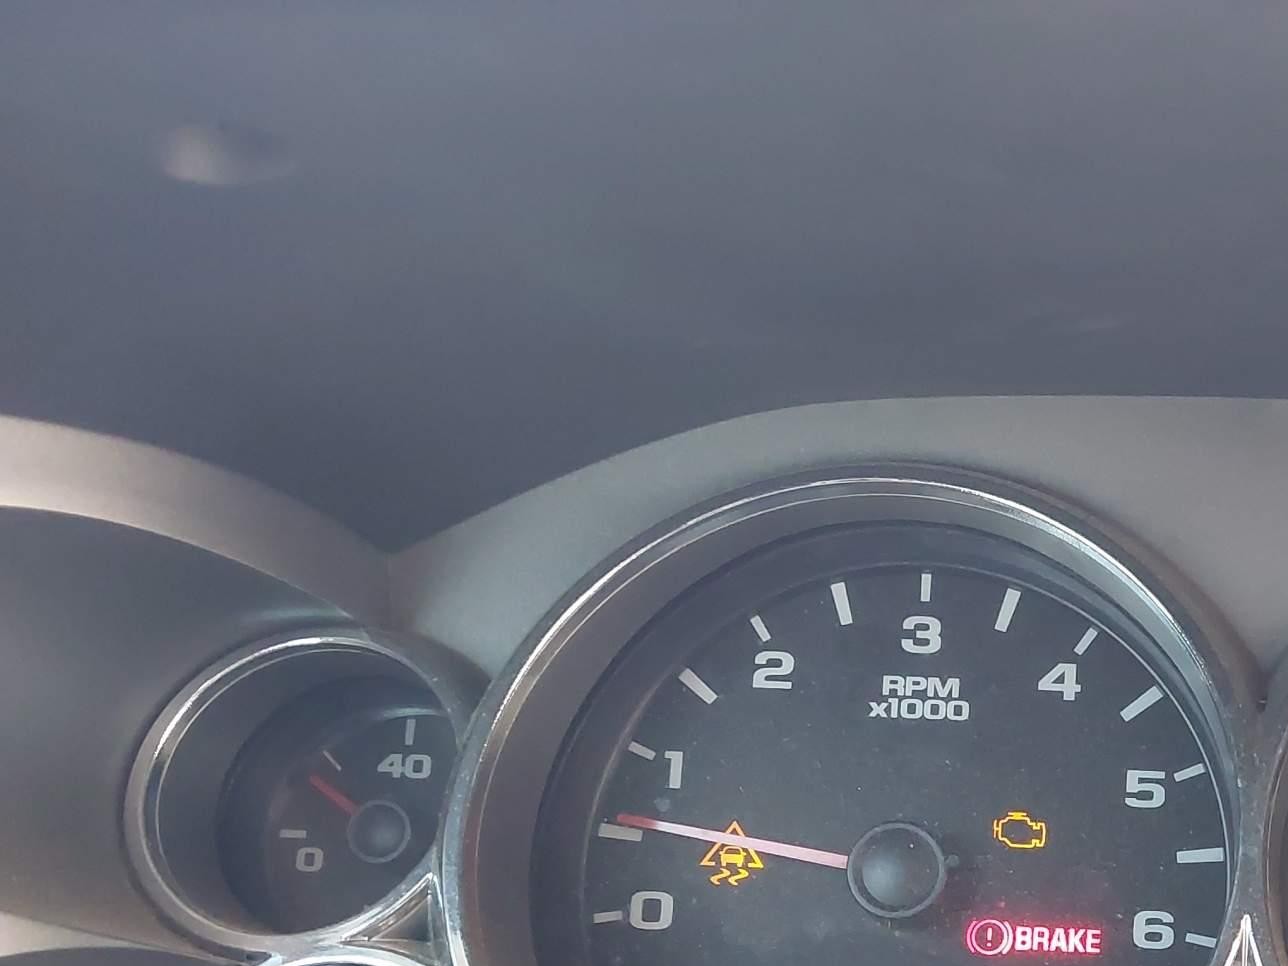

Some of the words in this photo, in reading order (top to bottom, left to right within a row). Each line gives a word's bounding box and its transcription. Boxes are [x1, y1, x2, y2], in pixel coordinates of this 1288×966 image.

[902, 615, 942, 654] 3
[752, 650, 795, 690] 2
[881, 675, 960, 697] RPM
[1037, 662, 1081, 700] 4
[868, 698, 969, 722] x1000
[377, 753, 432, 779] 40
[664, 750, 683, 789] 1
[1124, 769, 1166, 809] 5
[295, 847, 324, 872] 0
[629, 890, 674, 930] 0
[1014, 928, 1101, 953] BRAKE
[1132, 911, 1174, 950] 6
